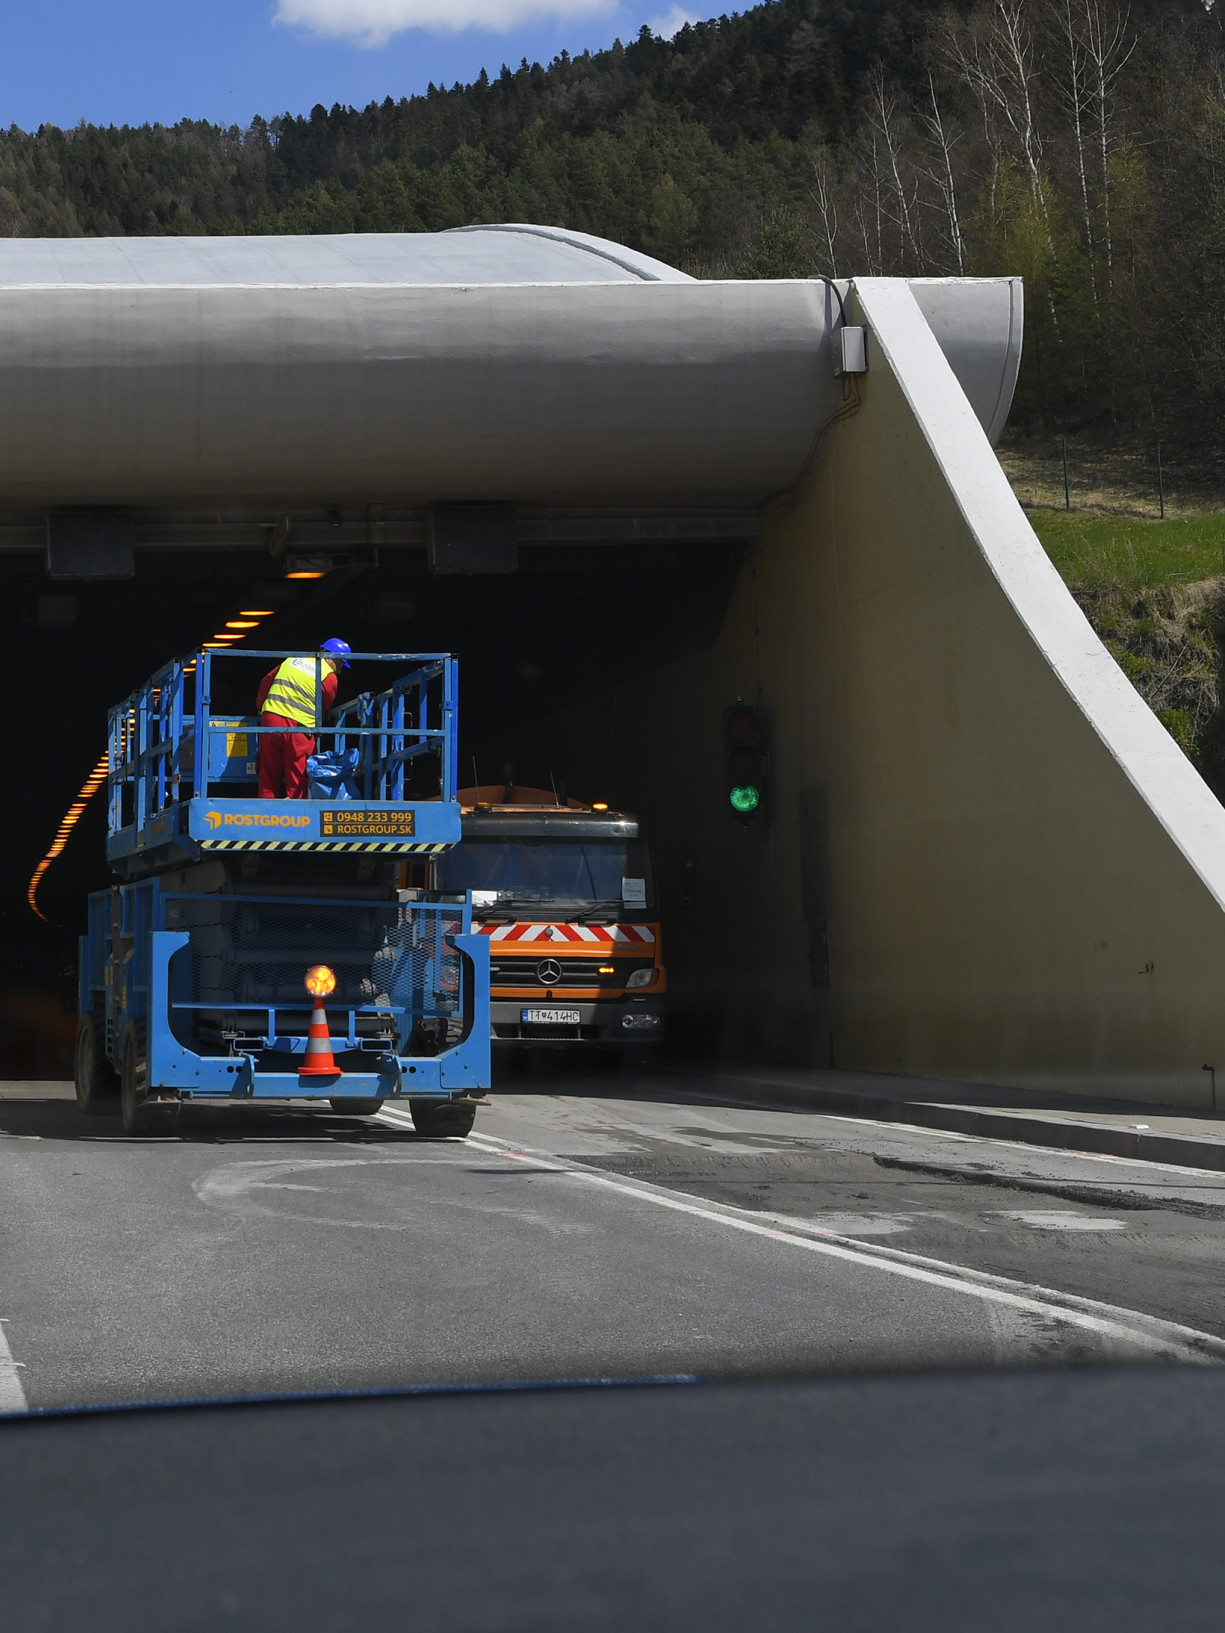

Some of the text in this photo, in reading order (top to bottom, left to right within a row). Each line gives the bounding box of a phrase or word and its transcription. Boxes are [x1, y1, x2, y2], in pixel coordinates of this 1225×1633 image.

[224, 813, 311, 828] ROSTGROUP
[337, 812, 412, 822] 0948 233 999
[337, 825, 412, 834] ROSTGROUP.SK
